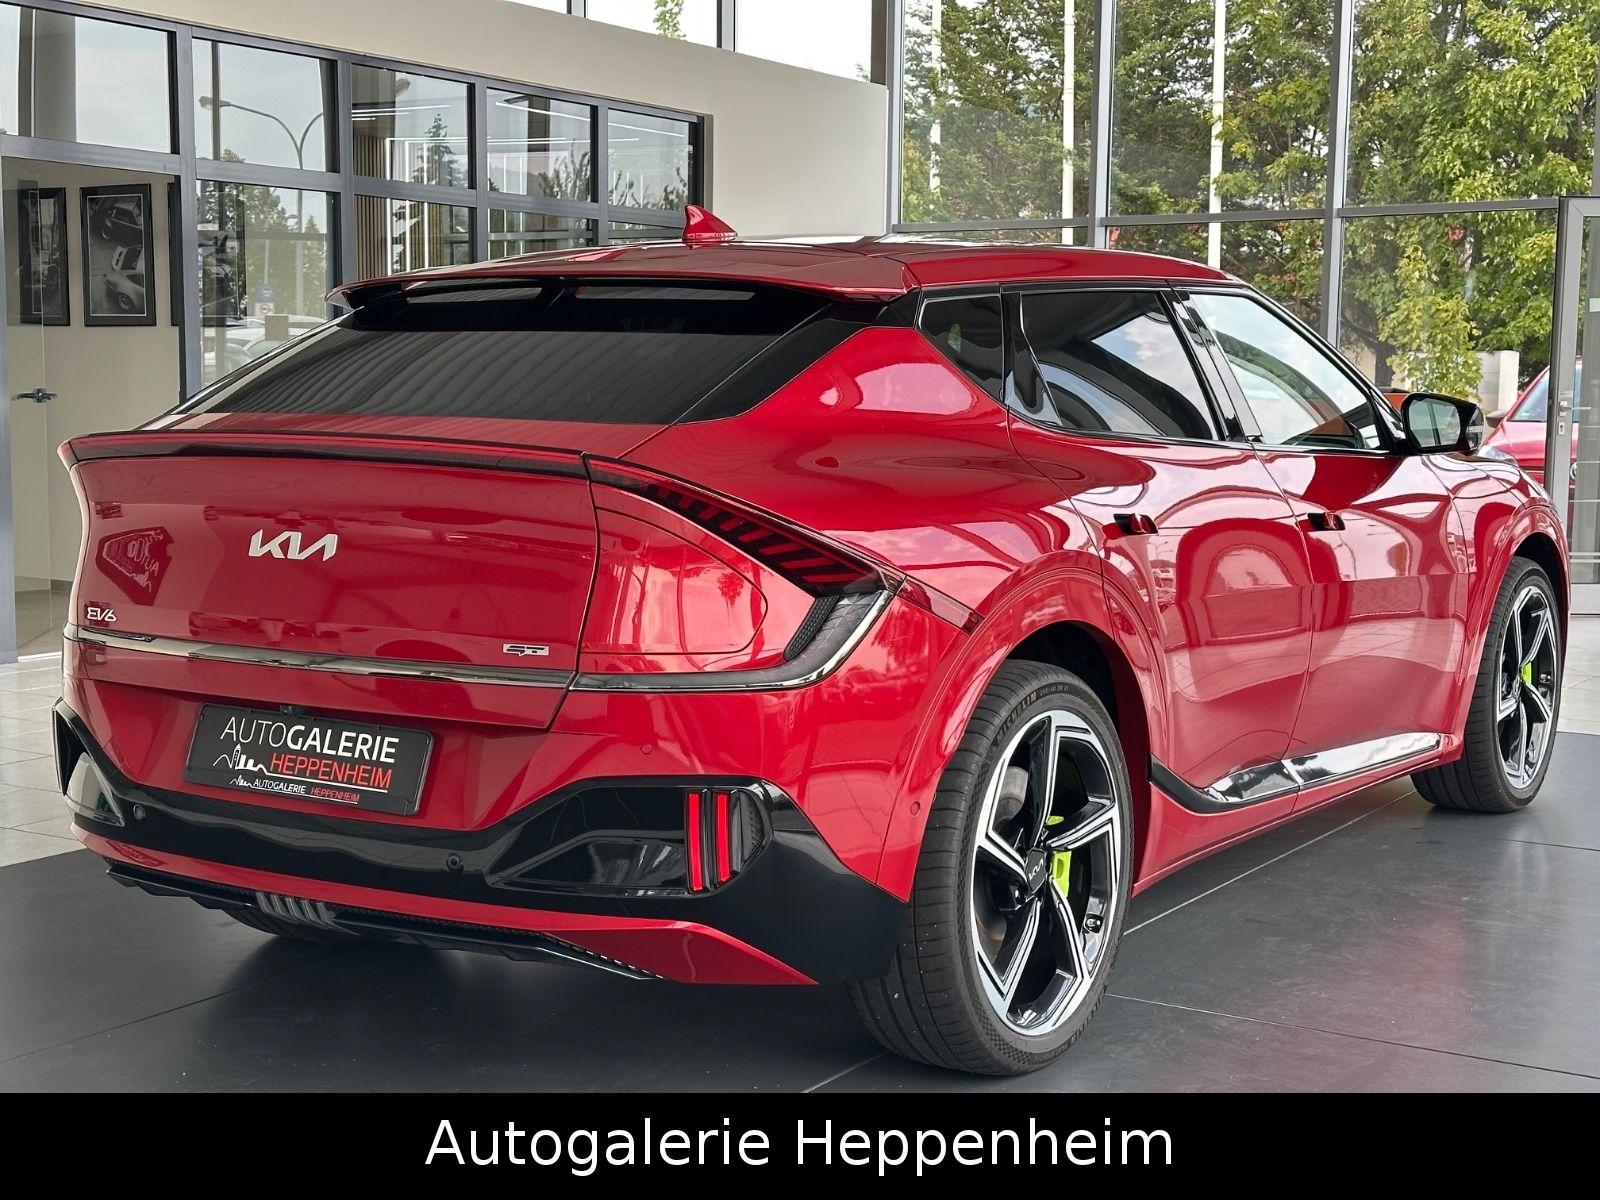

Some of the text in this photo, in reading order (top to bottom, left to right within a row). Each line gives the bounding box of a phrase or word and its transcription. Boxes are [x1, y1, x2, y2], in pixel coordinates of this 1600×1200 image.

[249, 529, 338, 561] KIA
[87, 607, 117, 622] EV6
[503, 643, 549, 656] GT
[220, 716, 399, 763] AUTOGALERIE
[269, 753, 392, 788] HEPPENHEIM
[253, 778, 360, 802] AUTOGALERIE HEPPENHEIM
